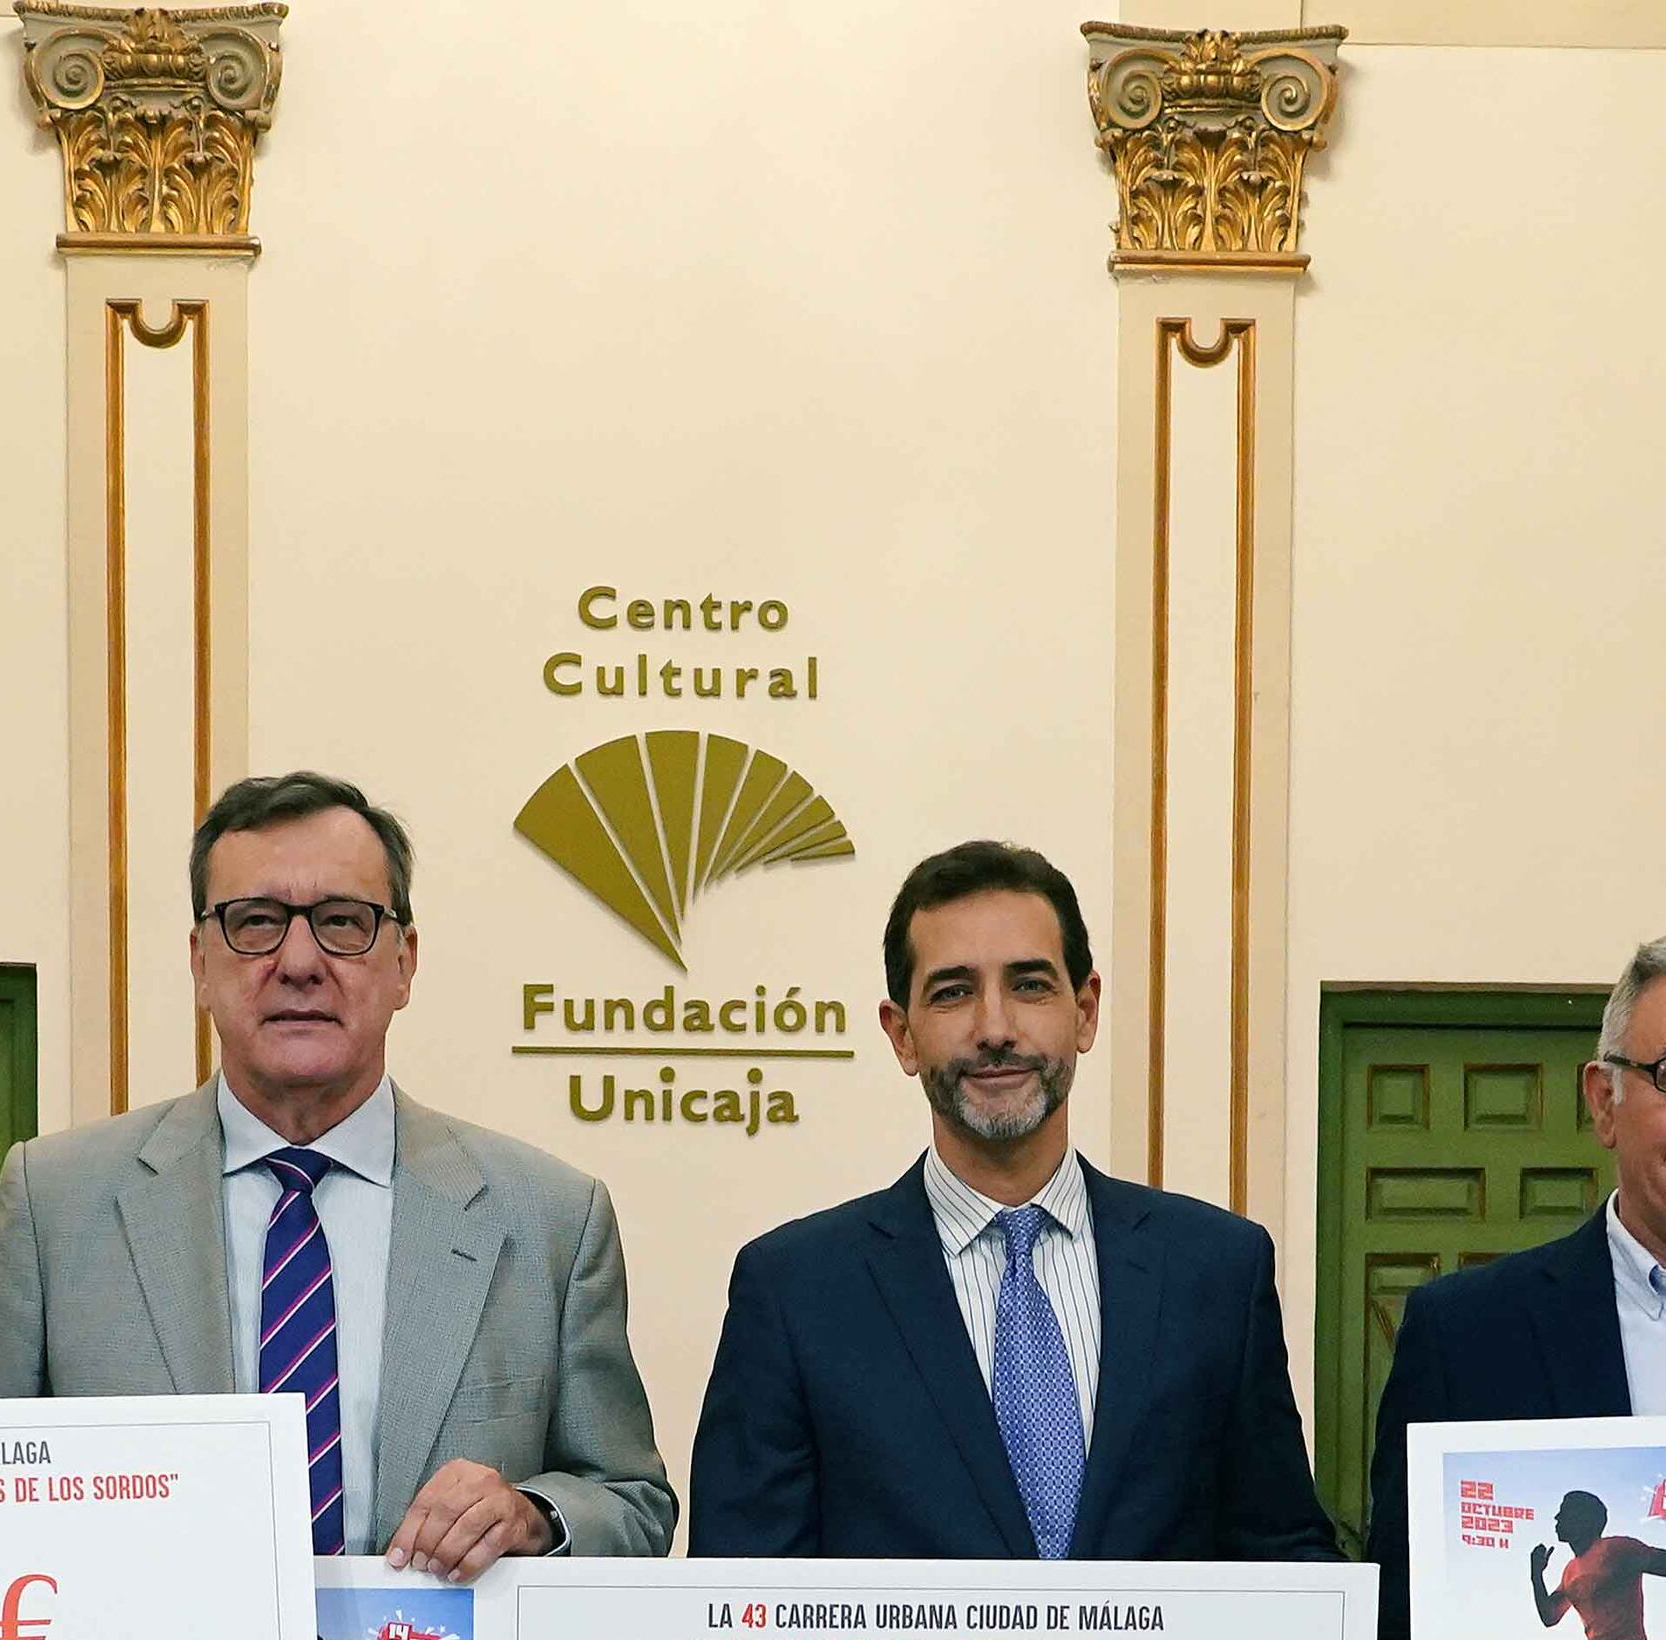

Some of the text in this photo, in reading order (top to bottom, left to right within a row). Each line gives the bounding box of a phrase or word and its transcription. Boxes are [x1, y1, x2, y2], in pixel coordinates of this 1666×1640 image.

[577, 586, 789, 632] Centro
[542, 652, 819, 699] Cultural
[521, 983, 847, 1035] Fundación
[568, 1066, 800, 1137] Unicaja
[15, 1477, 39, 1502] DE
[49, 1476, 84, 1502] LOS
[1461, 1480, 1493, 1500] 22
[1461, 1502, 1534, 1520] OCTUBRE
[1461, 1515, 1513, 1533] 2023
[1462, 1534, 1495, 1547] 9:30
[708, 1600, 1163, 1631] LA 43 CARRERA URBANA CIUDAD DE MÁLAGA
